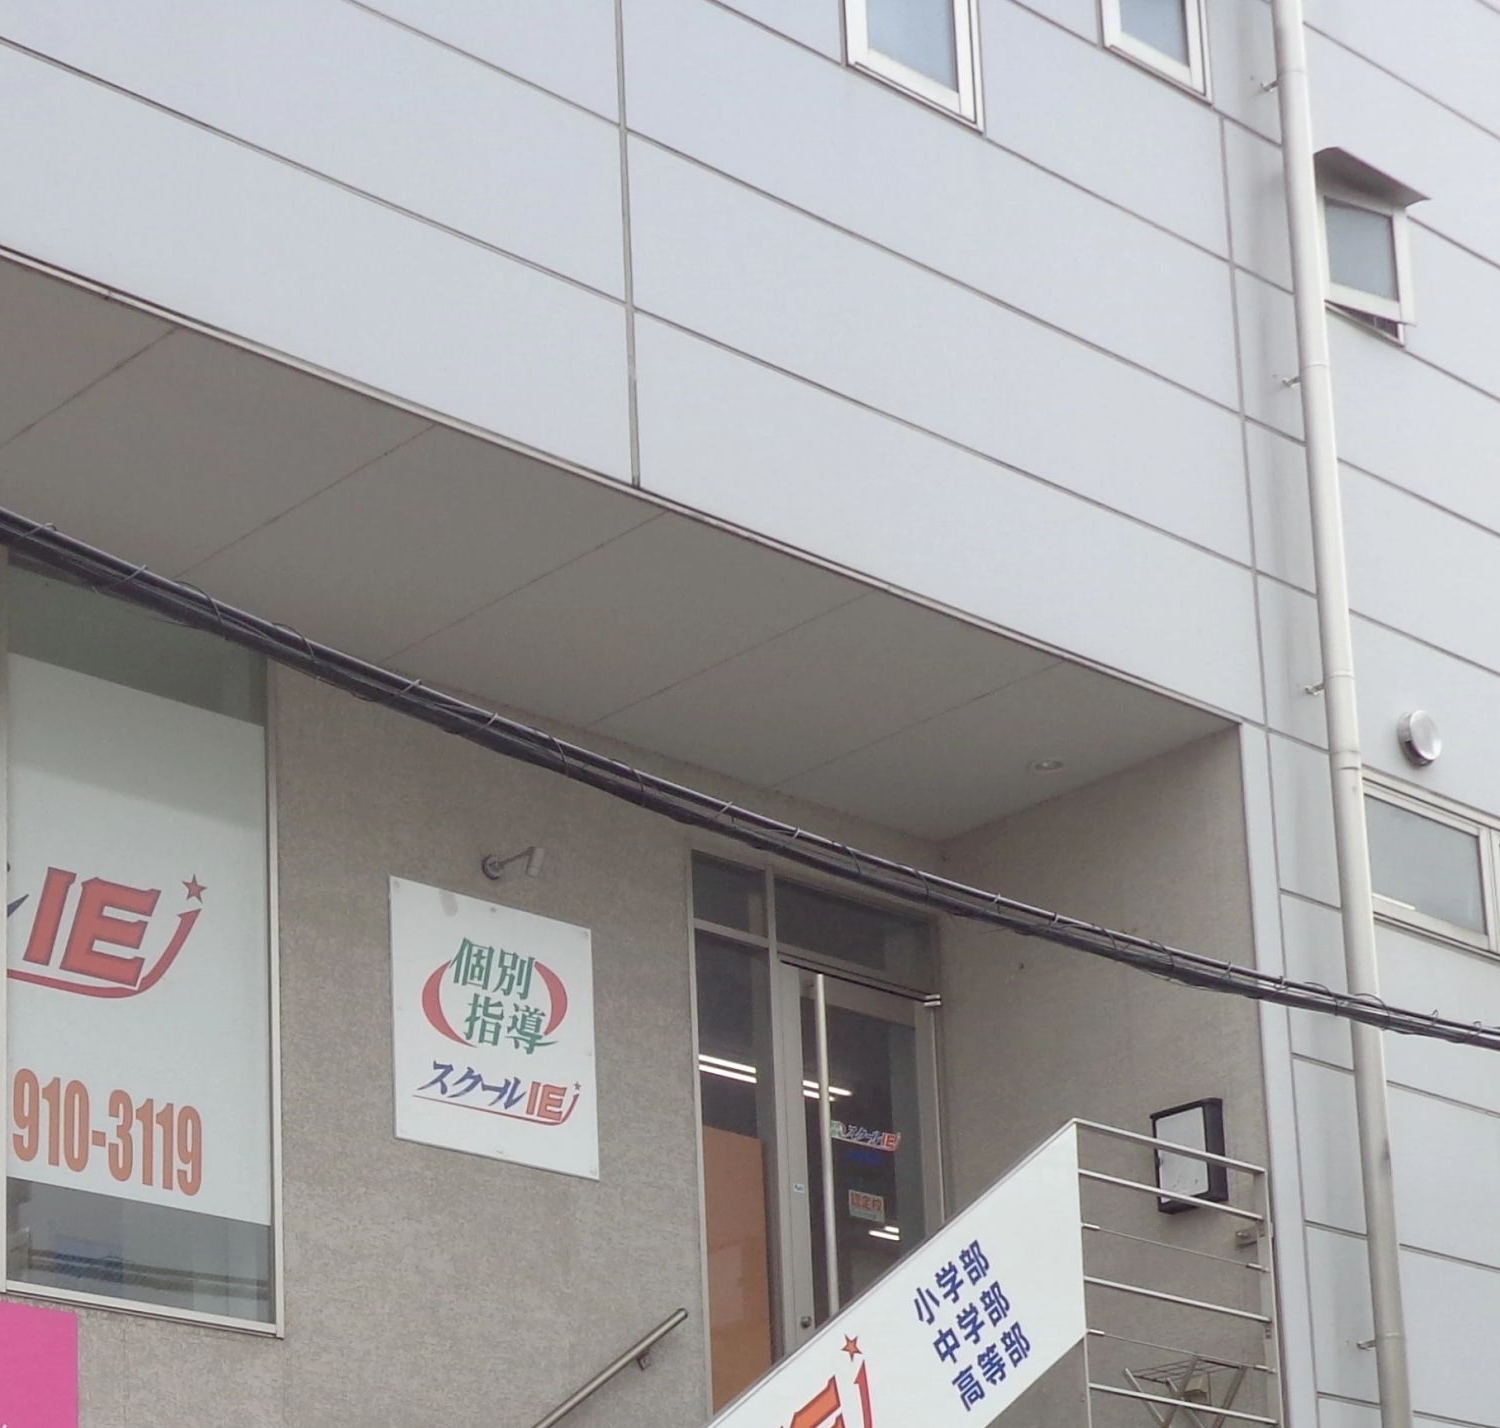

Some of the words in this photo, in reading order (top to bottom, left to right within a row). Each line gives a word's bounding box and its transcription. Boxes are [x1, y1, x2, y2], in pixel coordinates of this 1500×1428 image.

[450, 937, 540, 1001] 個別
[463, 994, 559, 1056] 指導
[417, 1059, 567, 1122] スクールIE
[911, 1239, 991, 1327] 小学部
[932, 1279, 1011, 1367] 中学部
[949, 1322, 1031, 1412] 高等部
